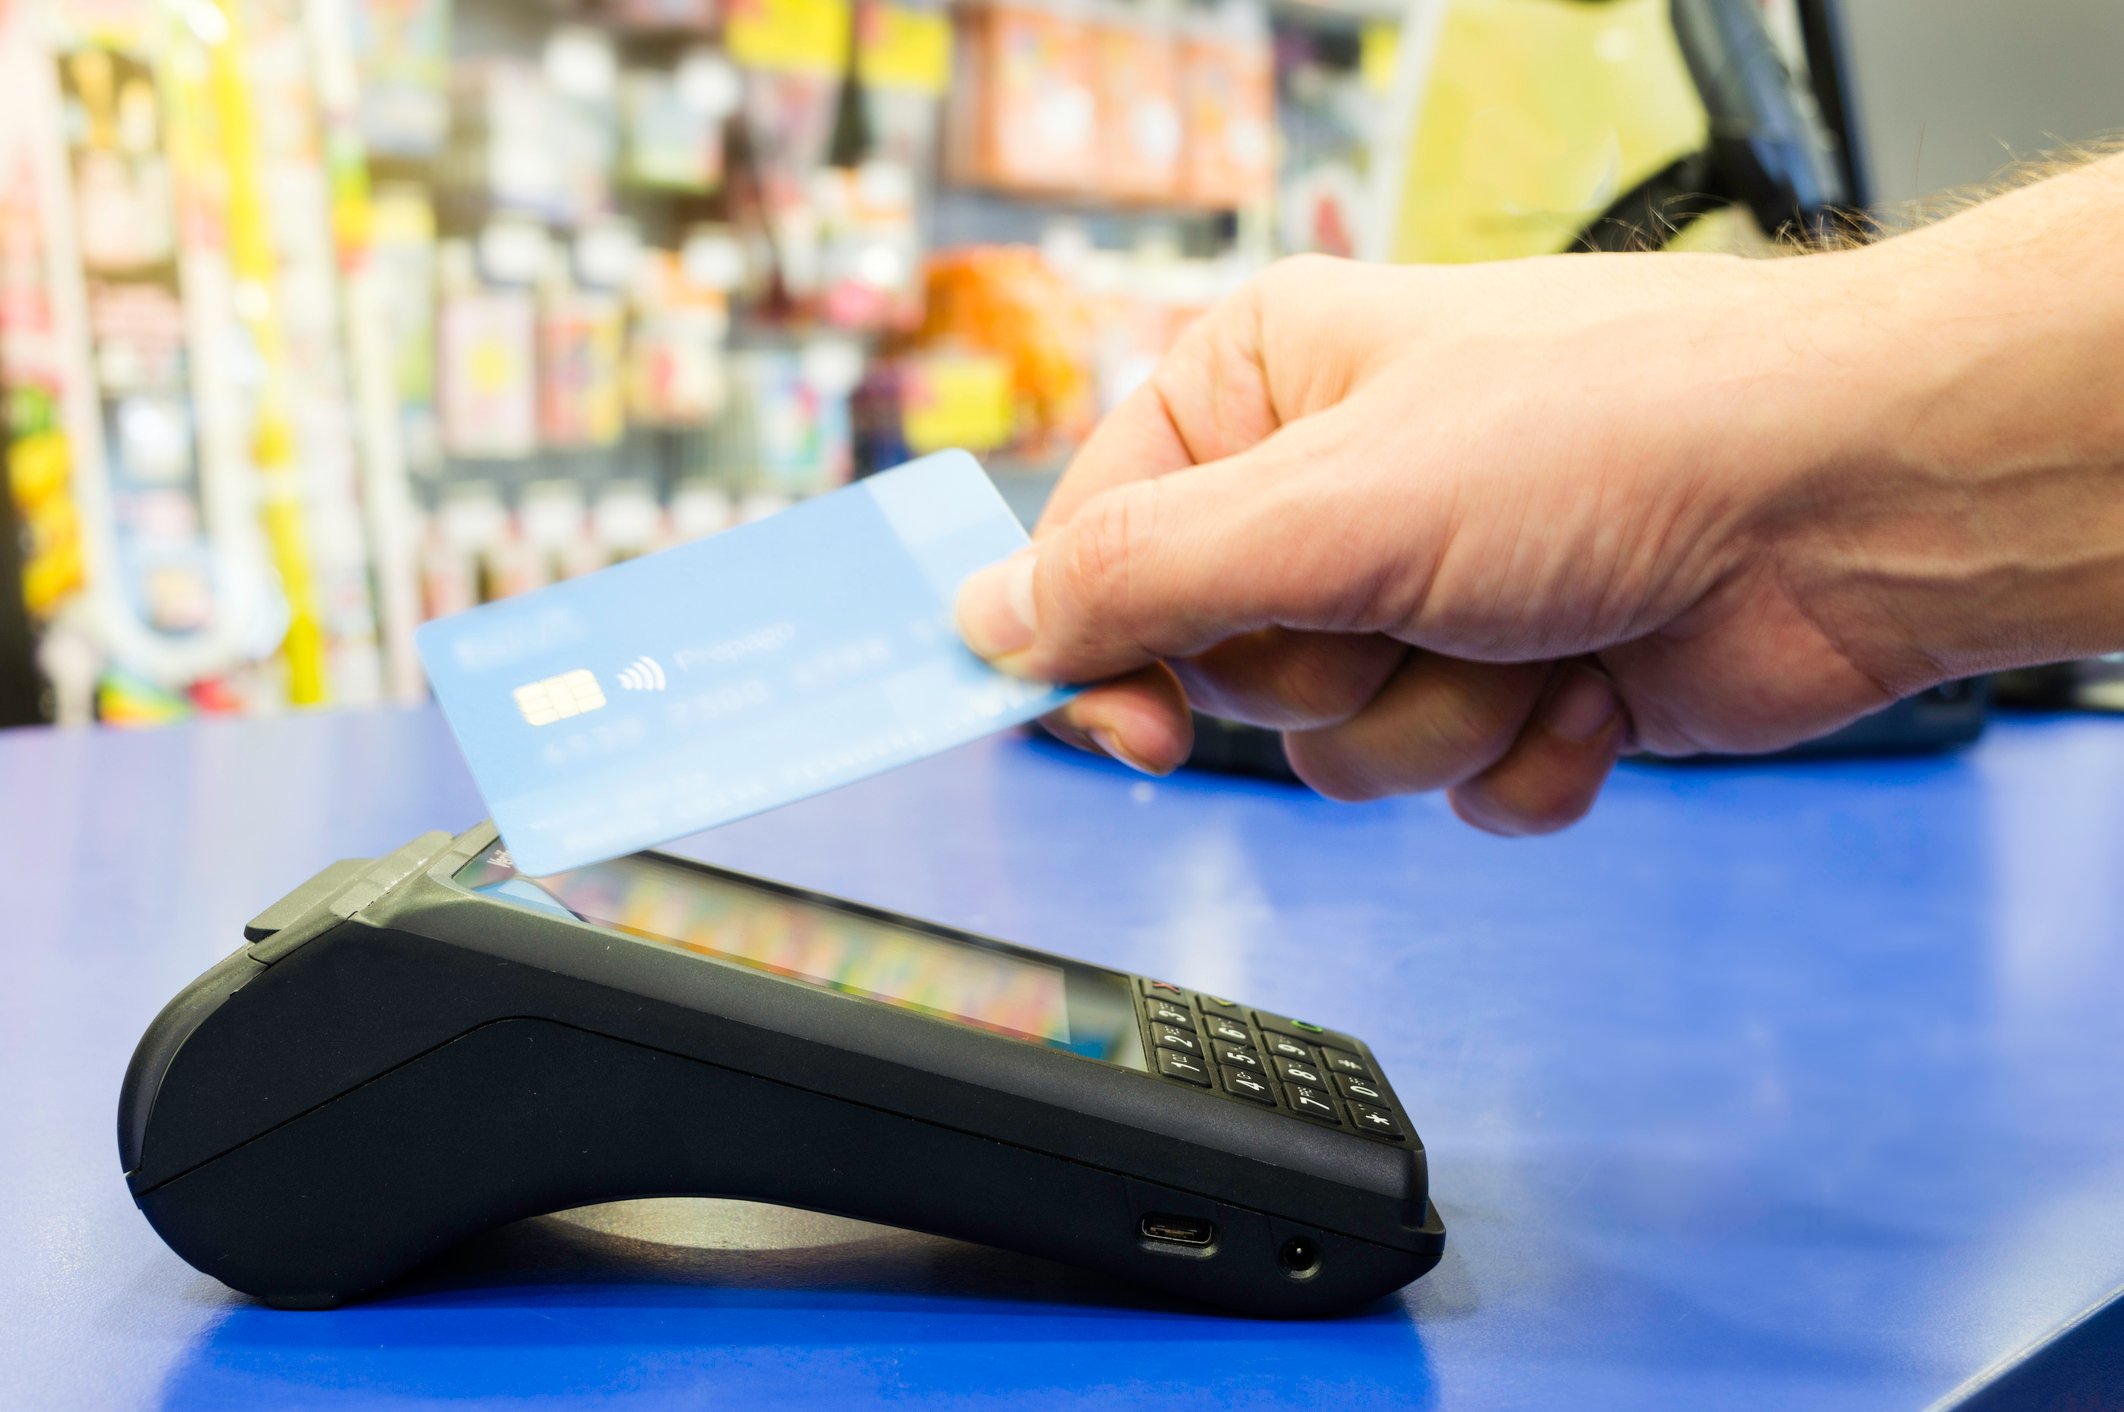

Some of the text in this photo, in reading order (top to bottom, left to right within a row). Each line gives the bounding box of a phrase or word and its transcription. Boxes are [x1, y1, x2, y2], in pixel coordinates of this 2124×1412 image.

[1159, 1010, 1186, 1022] 3
[1218, 1027, 1246, 1039] 6
[1164, 1035, 1193, 1048] 2
[1278, 1044, 1306, 1056] 9
[1227, 1052, 1255, 1065] 5
[1171, 1061, 1200, 1072] 1
[1288, 1068, 1317, 1081] 8
[1236, 1079, 1265, 1091] 4
[1350, 1085, 1379, 1098] 0
[1300, 1096, 1330, 1110] 7
